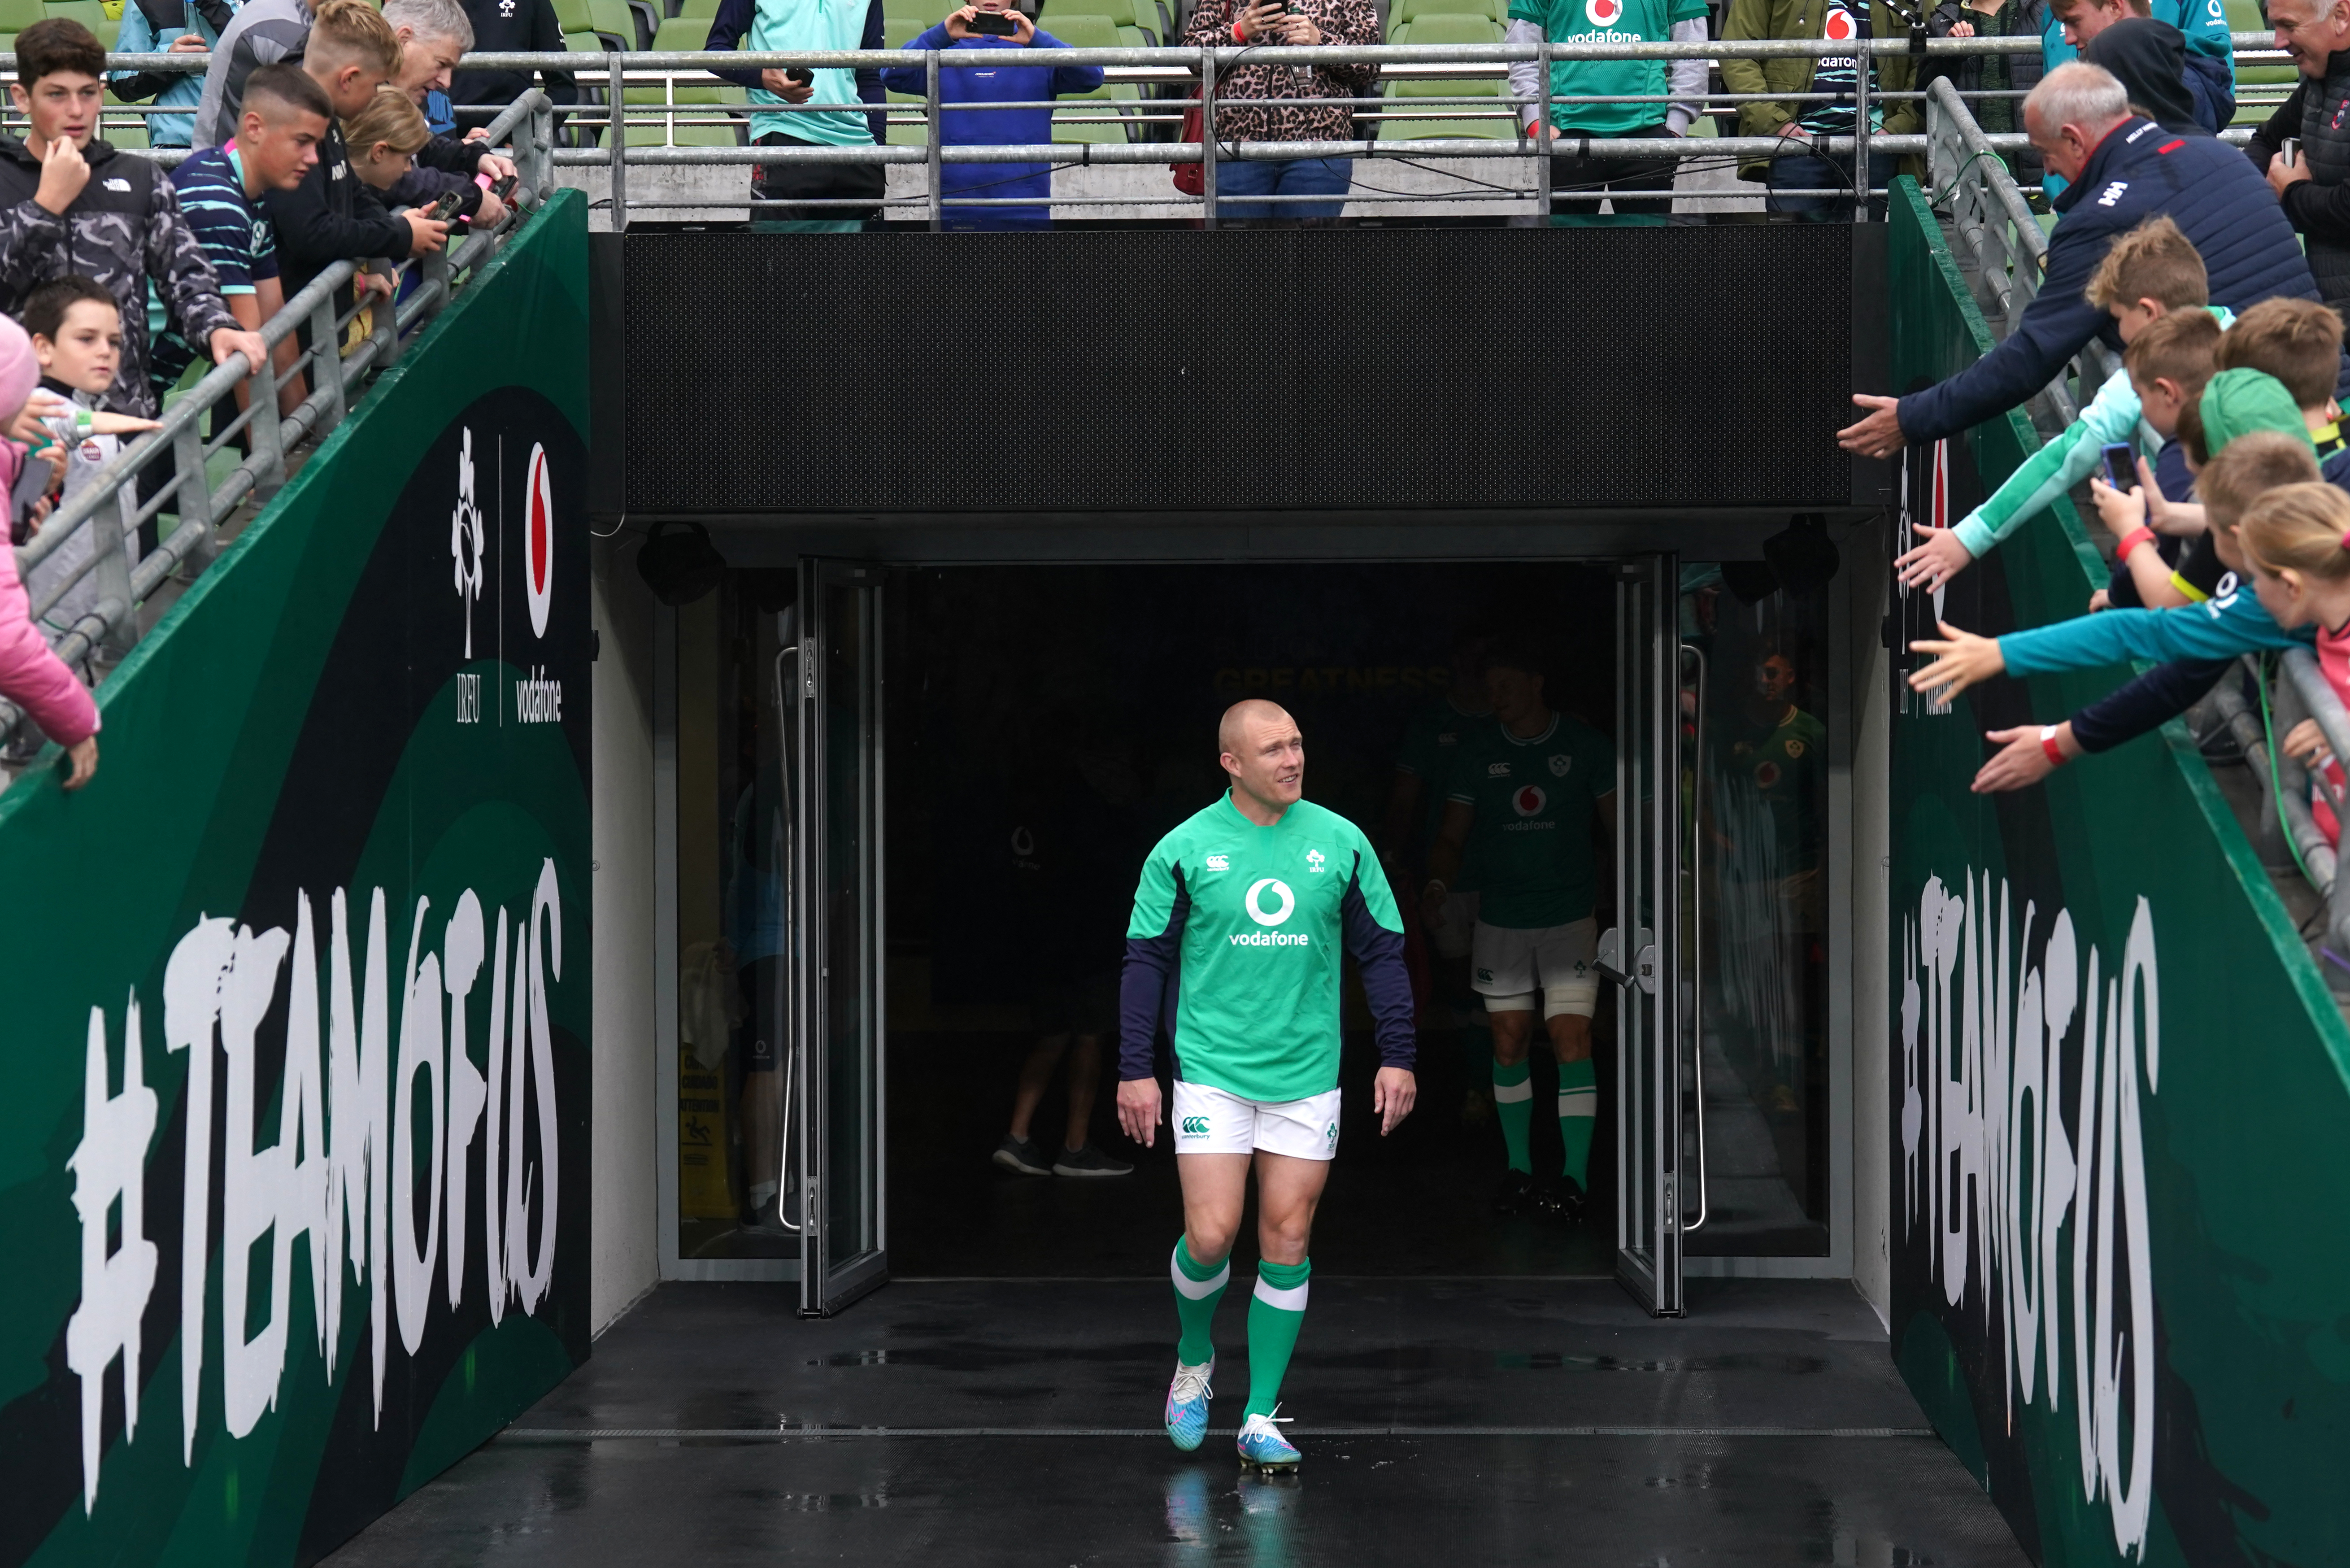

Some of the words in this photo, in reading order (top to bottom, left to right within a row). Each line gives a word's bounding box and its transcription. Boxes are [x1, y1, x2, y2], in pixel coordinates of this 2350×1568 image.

[1567, 29, 1641, 43] vodafone
[457, 673, 481, 723] IRFU
[516, 665, 561, 723] vodafone
[1214, 667, 1451, 692] GREATNESS
[1502, 820, 1555, 832] vodafone
[1229, 931, 1308, 946] vodafone
[65, 856, 563, 1520] #TEAMOFUS
[1900, 863, 2159, 1564] #TEAMOFUS
